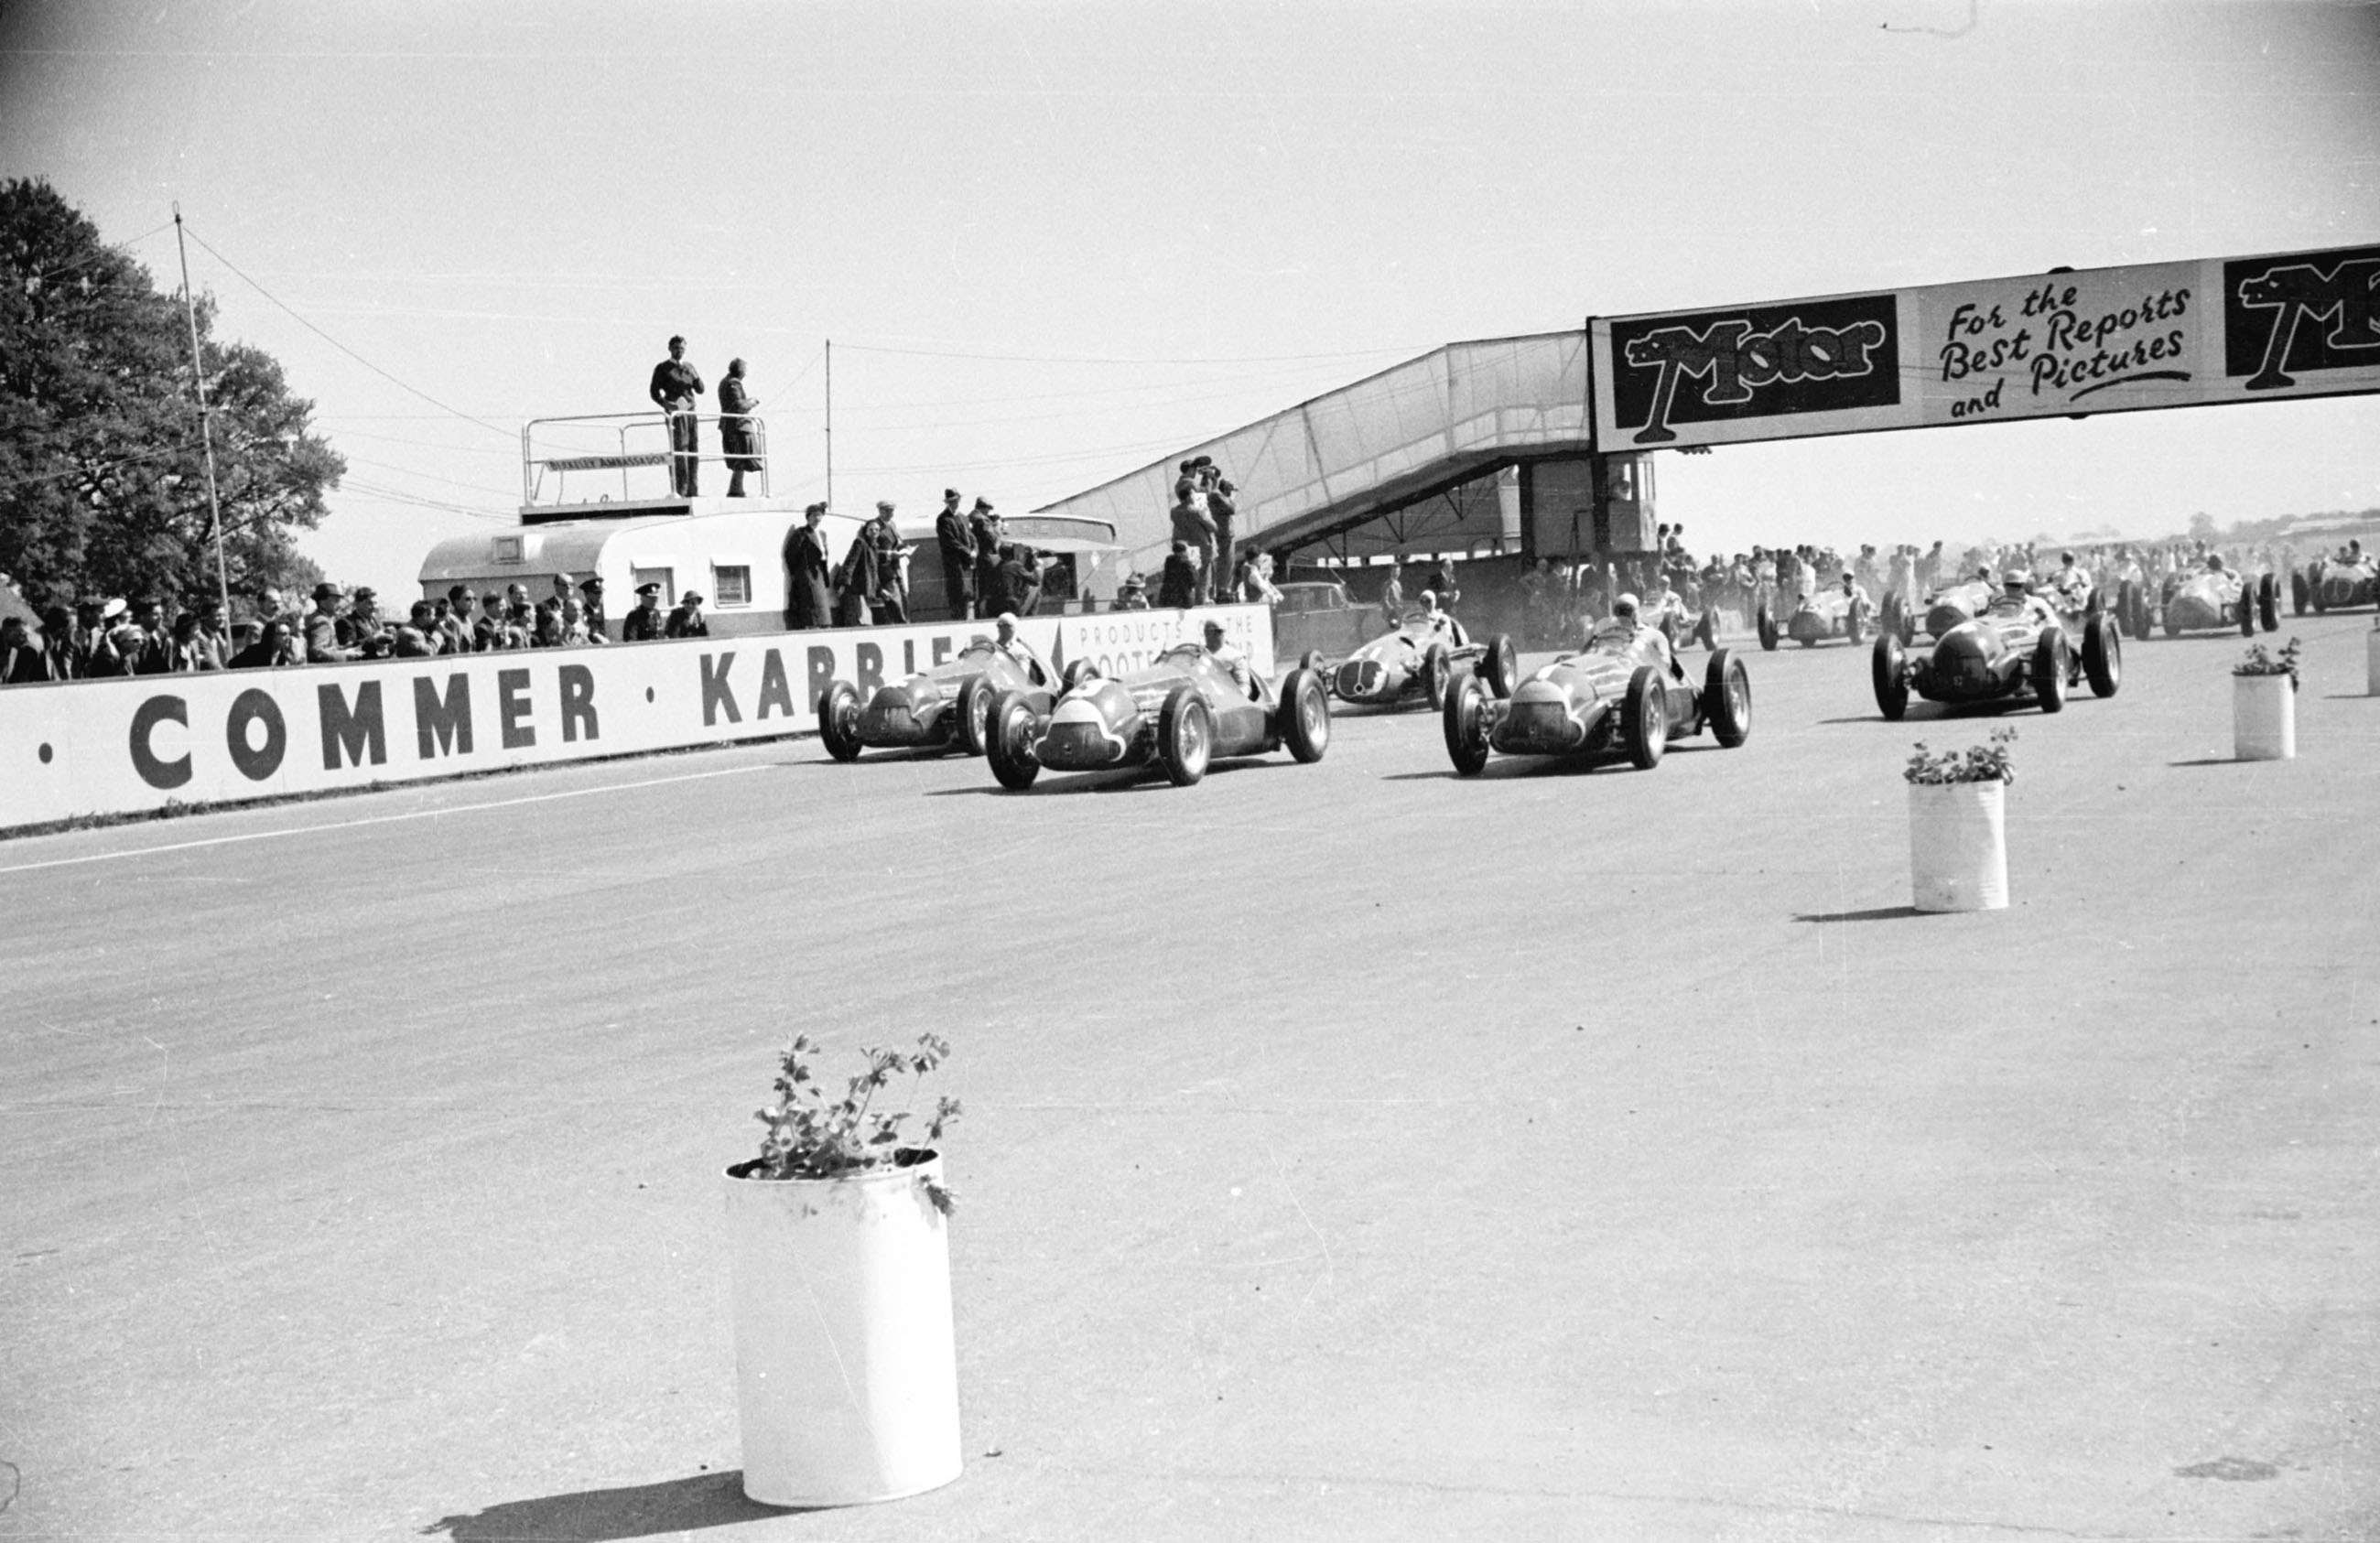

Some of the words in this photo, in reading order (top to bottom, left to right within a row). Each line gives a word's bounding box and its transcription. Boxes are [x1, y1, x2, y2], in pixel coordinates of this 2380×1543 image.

[1940, 328, 2031, 383] Best
[2047, 287, 2191, 351] Reports
[1948, 303, 2007, 341] For
[2020, 283, 2077, 318] the
[1625, 317, 1886, 444] Motor
[1951, 376, 2005, 418] and
[2029, 329, 2184, 396] Pictures
[1080, 620, 1182, 646] PRODUCTS
[129, 664, 600, 790] COMMER
[699, 634, 994, 727] KARRI
